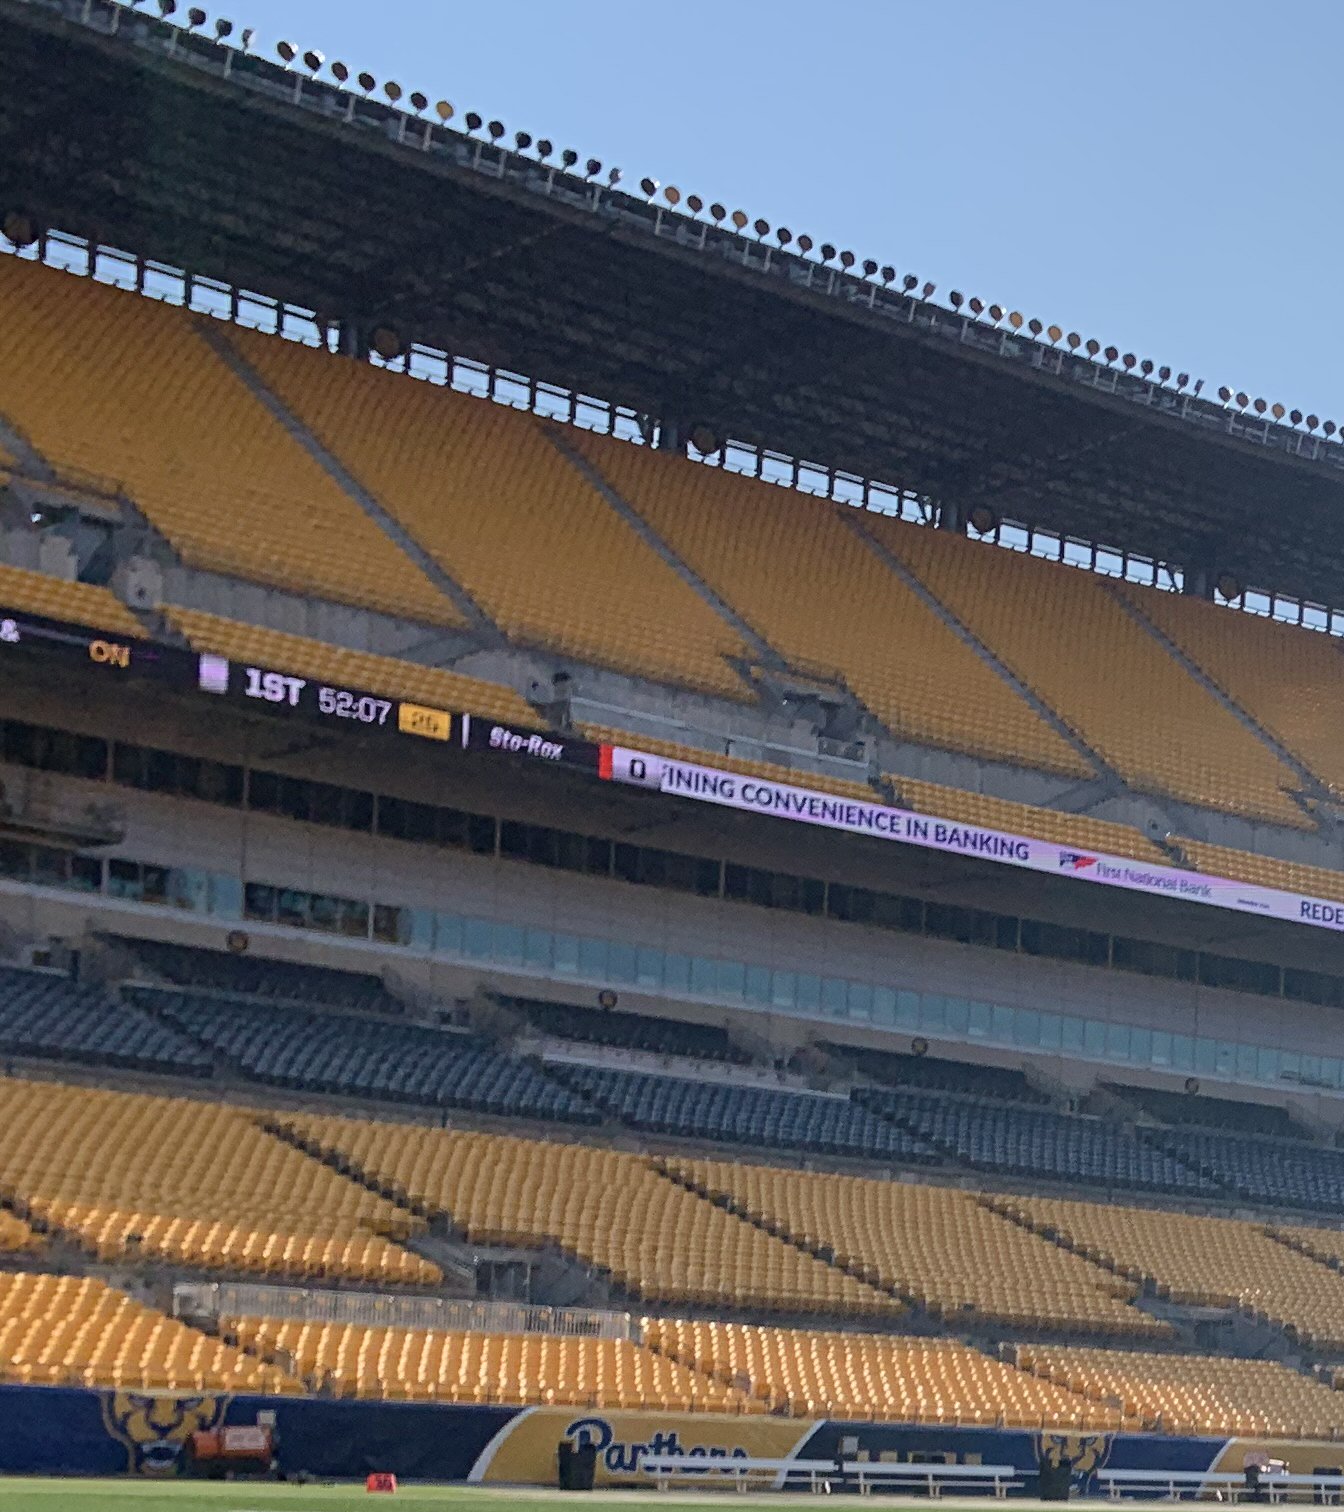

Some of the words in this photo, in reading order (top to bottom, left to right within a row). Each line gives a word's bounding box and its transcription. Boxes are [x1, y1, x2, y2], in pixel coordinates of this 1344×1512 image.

[245, 667, 306, 706] 1ST
[741, 782, 901, 834] CONVENIENCE
[906, 817, 929, 841] IN
[935, 824, 1030, 861] BANKING
[1180, 879, 1213, 898] Bank
